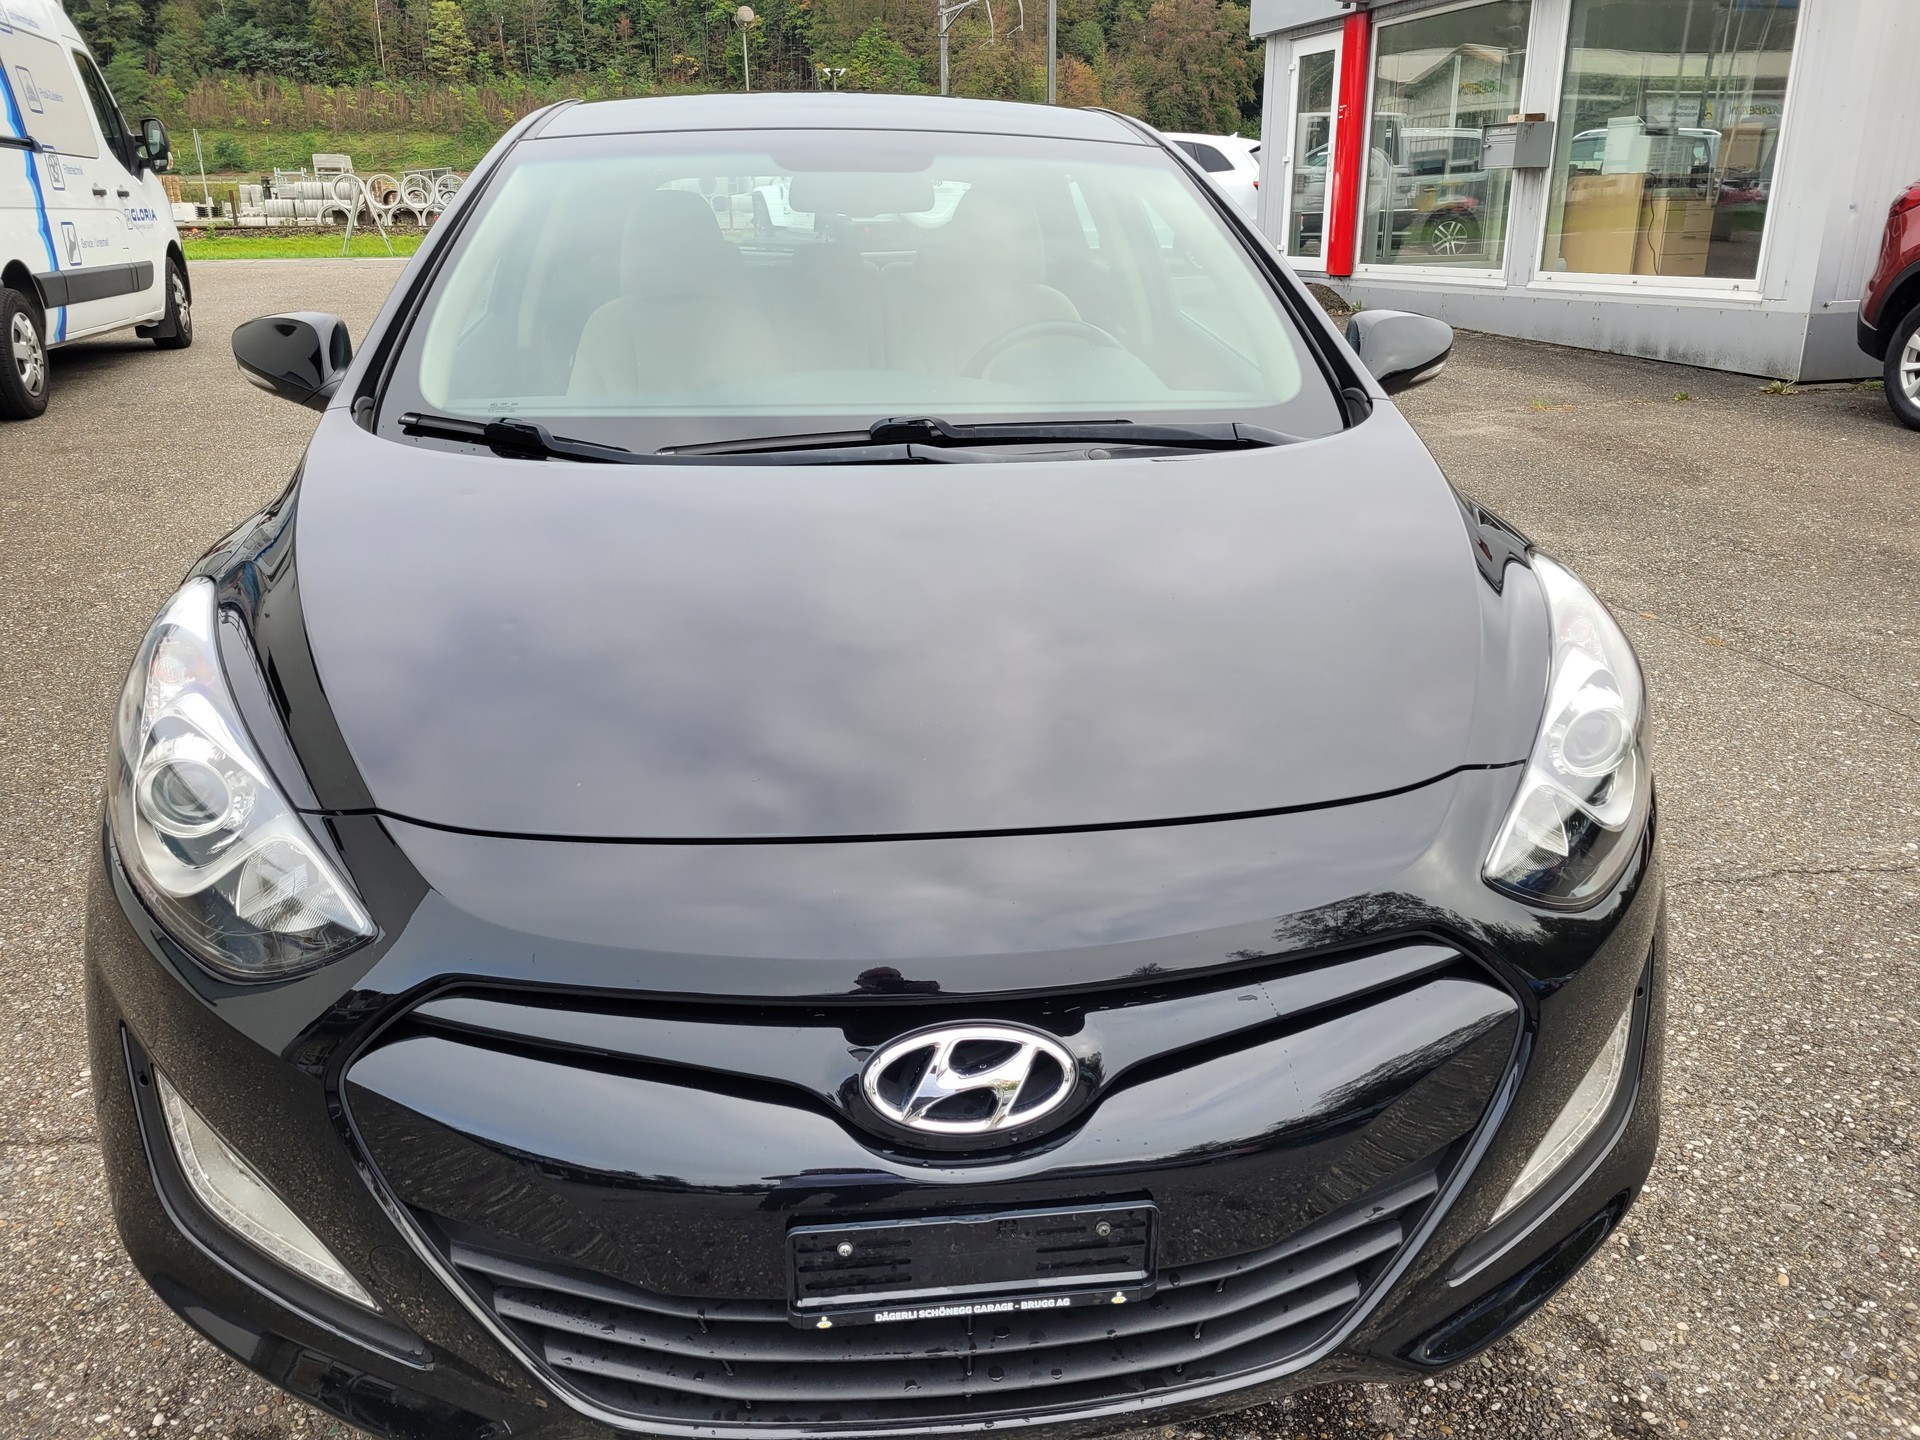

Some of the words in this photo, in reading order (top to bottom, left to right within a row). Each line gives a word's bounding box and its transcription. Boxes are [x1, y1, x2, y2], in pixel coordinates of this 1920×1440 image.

[131, 209, 158, 221] GLORIA
[875, 1311, 917, 1322] DÄGERLI
[919, 1306, 972, 1318] SCHÖNEGG
[973, 1303, 1013, 1314] GARAGE
[1021, 1299, 1055, 1310] BRUGG
[1056, 1298, 1070, 1307] AG
